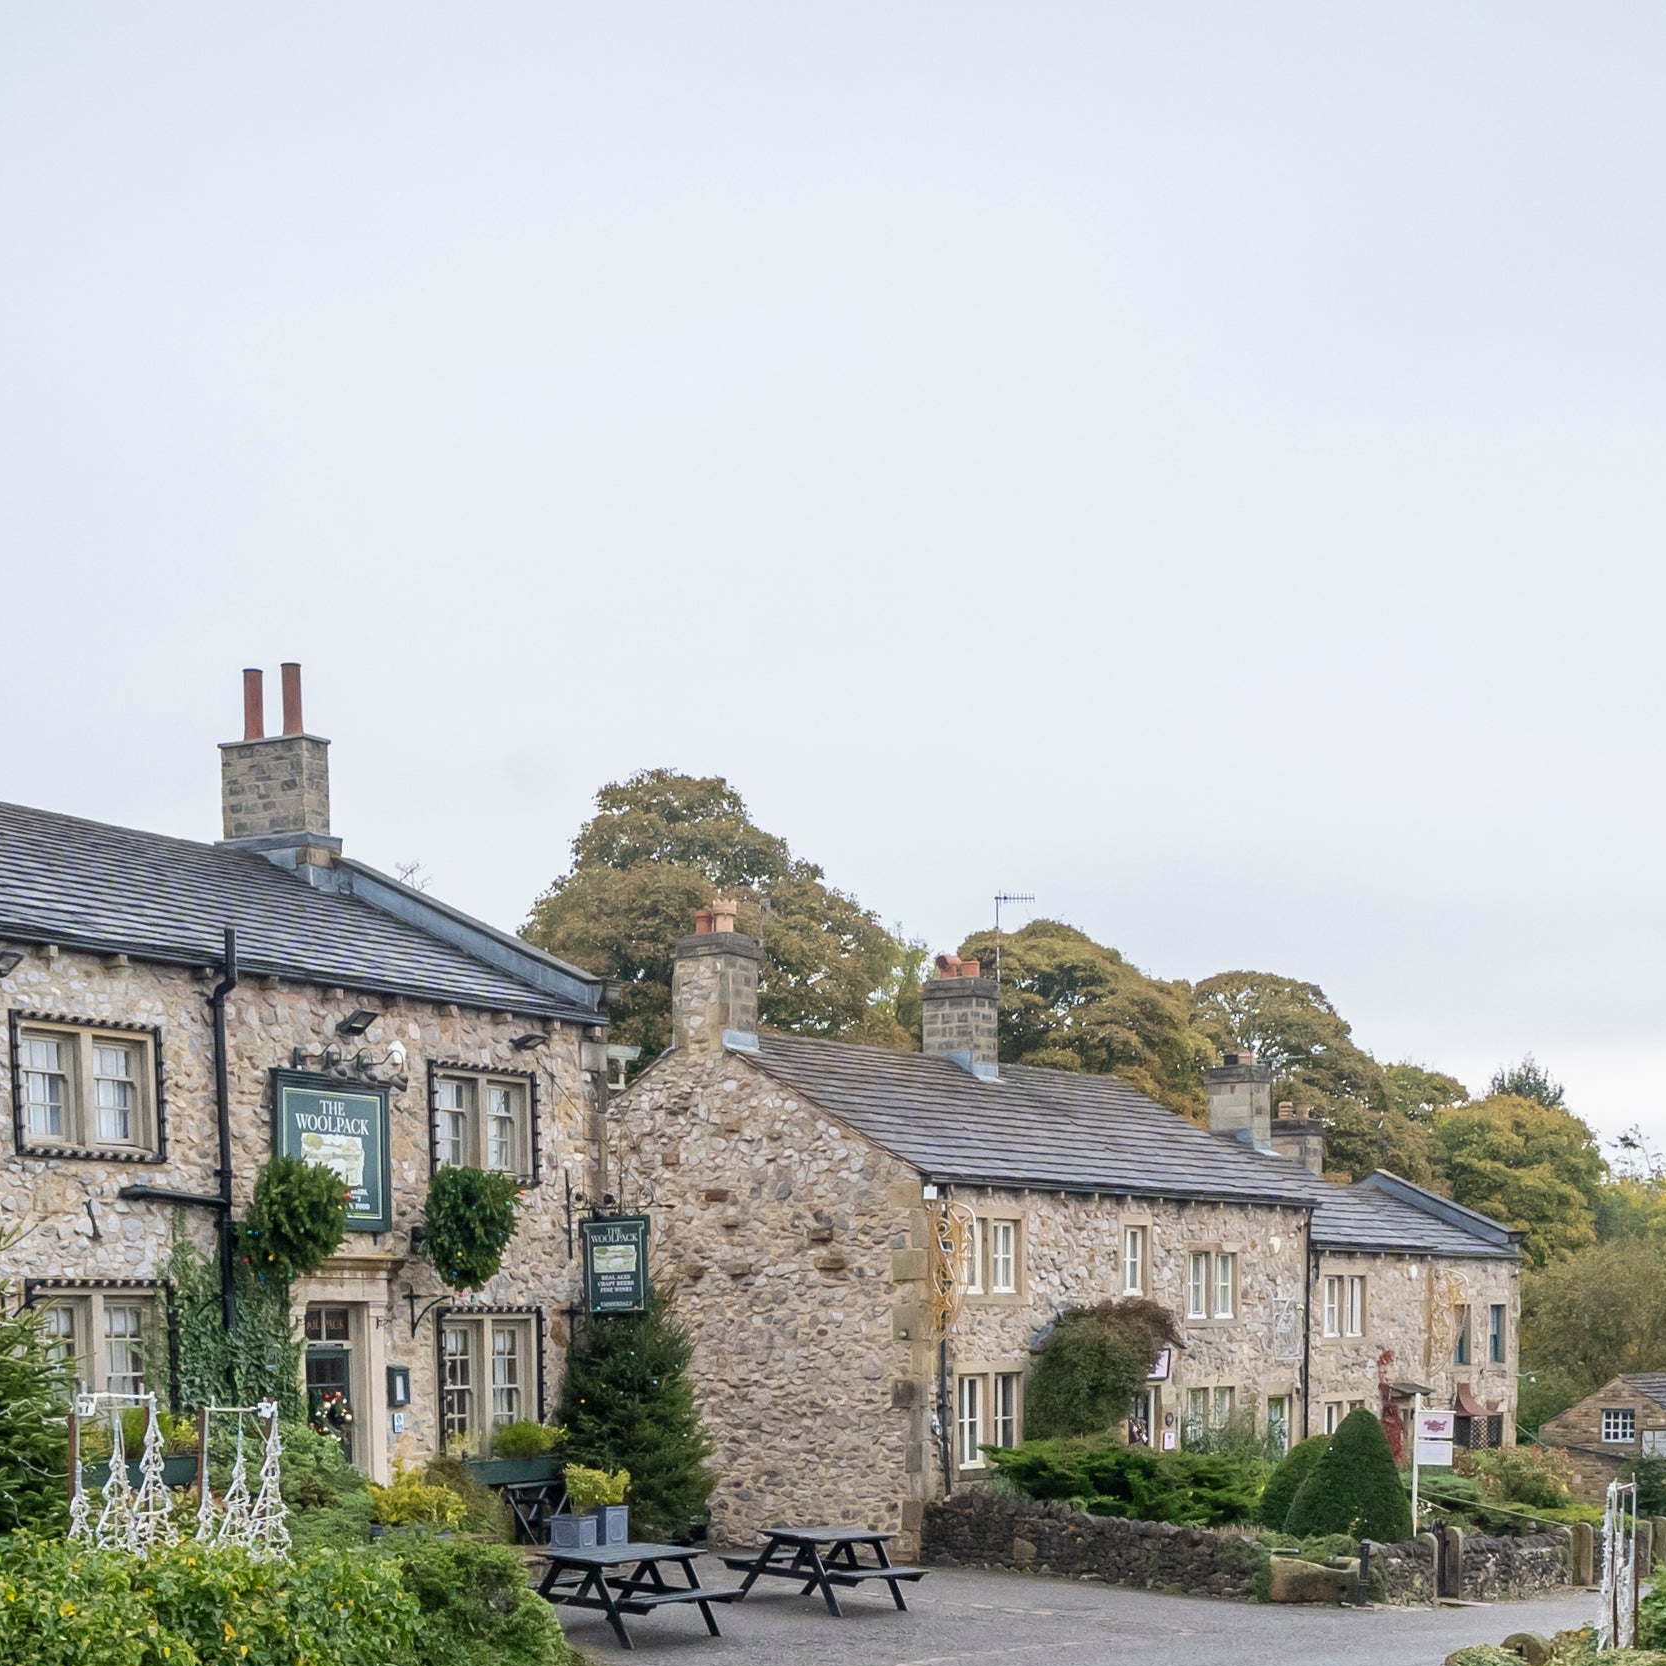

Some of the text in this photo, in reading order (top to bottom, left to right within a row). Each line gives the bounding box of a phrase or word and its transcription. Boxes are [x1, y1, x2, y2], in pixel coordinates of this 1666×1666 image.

[319, 1099, 346, 1116] THE
[295, 1112, 370, 1136] WOOLPACK
[591, 1233, 638, 1243] WOOLPACK
[606, 1227, 623, 1236] THE
